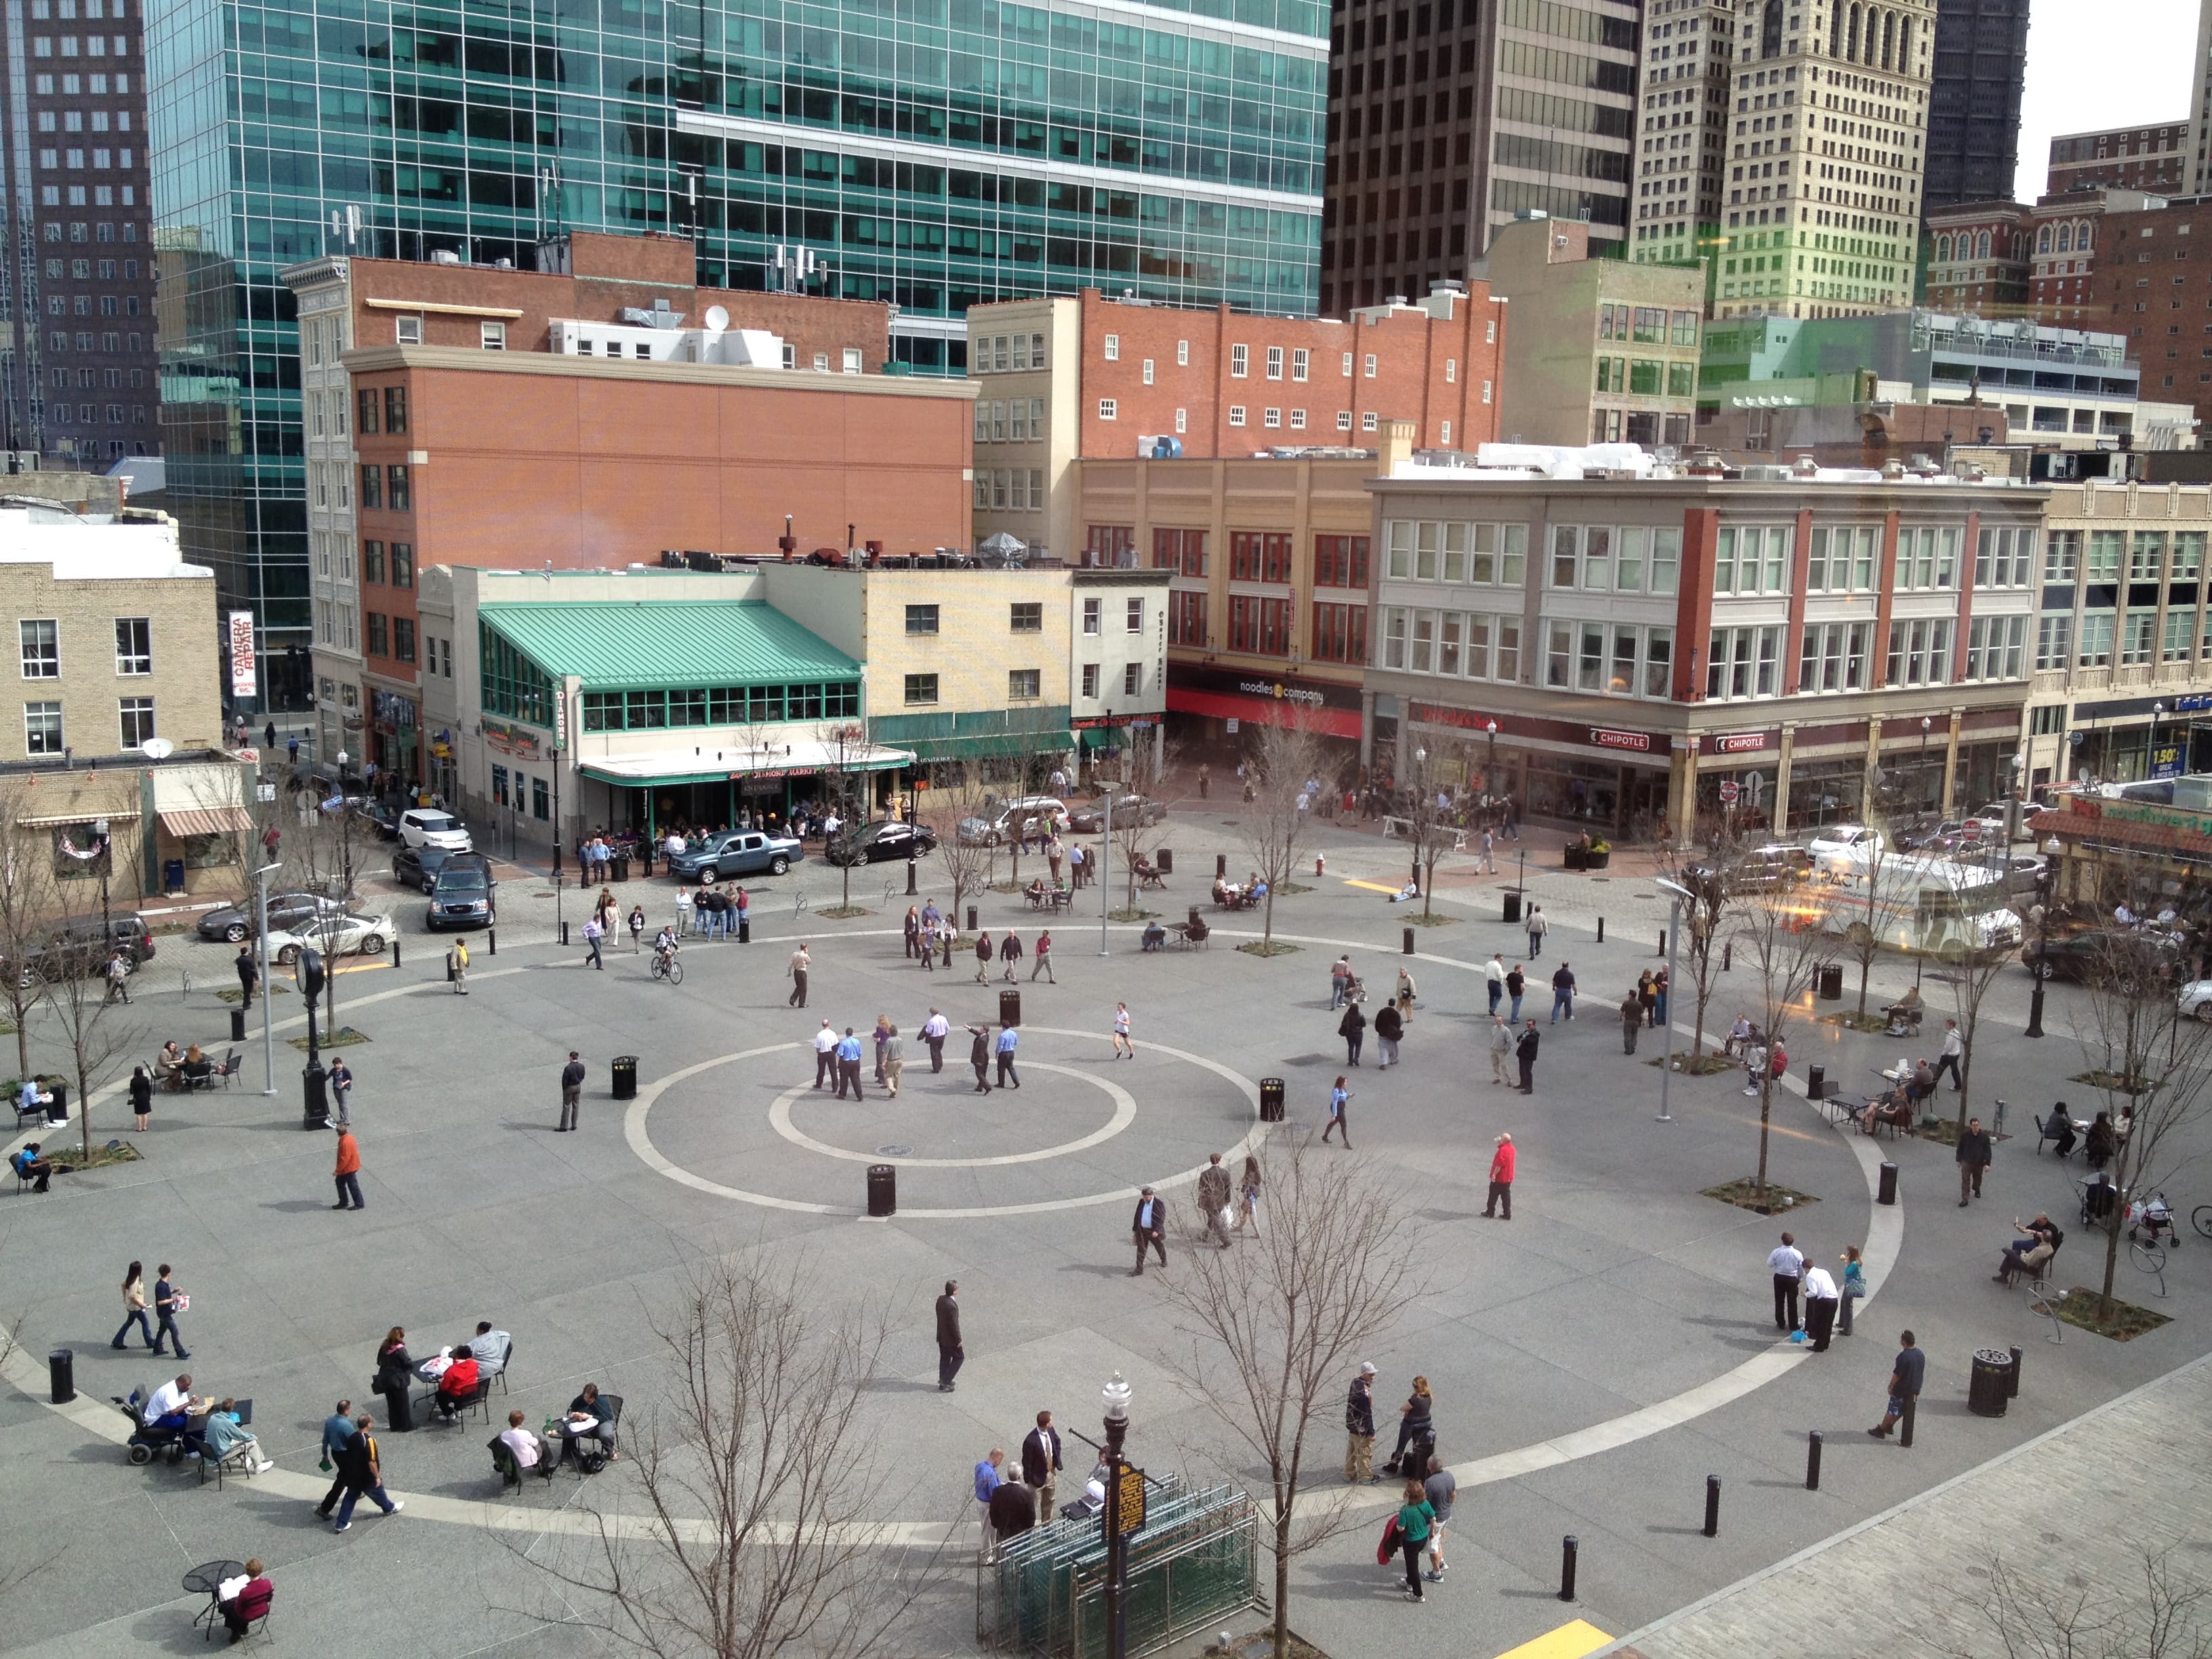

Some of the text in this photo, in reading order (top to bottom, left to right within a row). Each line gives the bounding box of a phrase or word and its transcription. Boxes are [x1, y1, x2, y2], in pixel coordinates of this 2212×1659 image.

[233, 618, 244, 676] CAMERA
[243, 621, 253, 670] REPAIR
[1240, 680, 1273, 695] noodles
[1284, 688, 1324, 705] company
[556, 691, 565, 739] DIAMOND
[1601, 733, 1645, 747] CHIPOTLE
[1729, 738, 1764, 748] CHIPOTLE
[787, 767, 817, 777] MARKET
